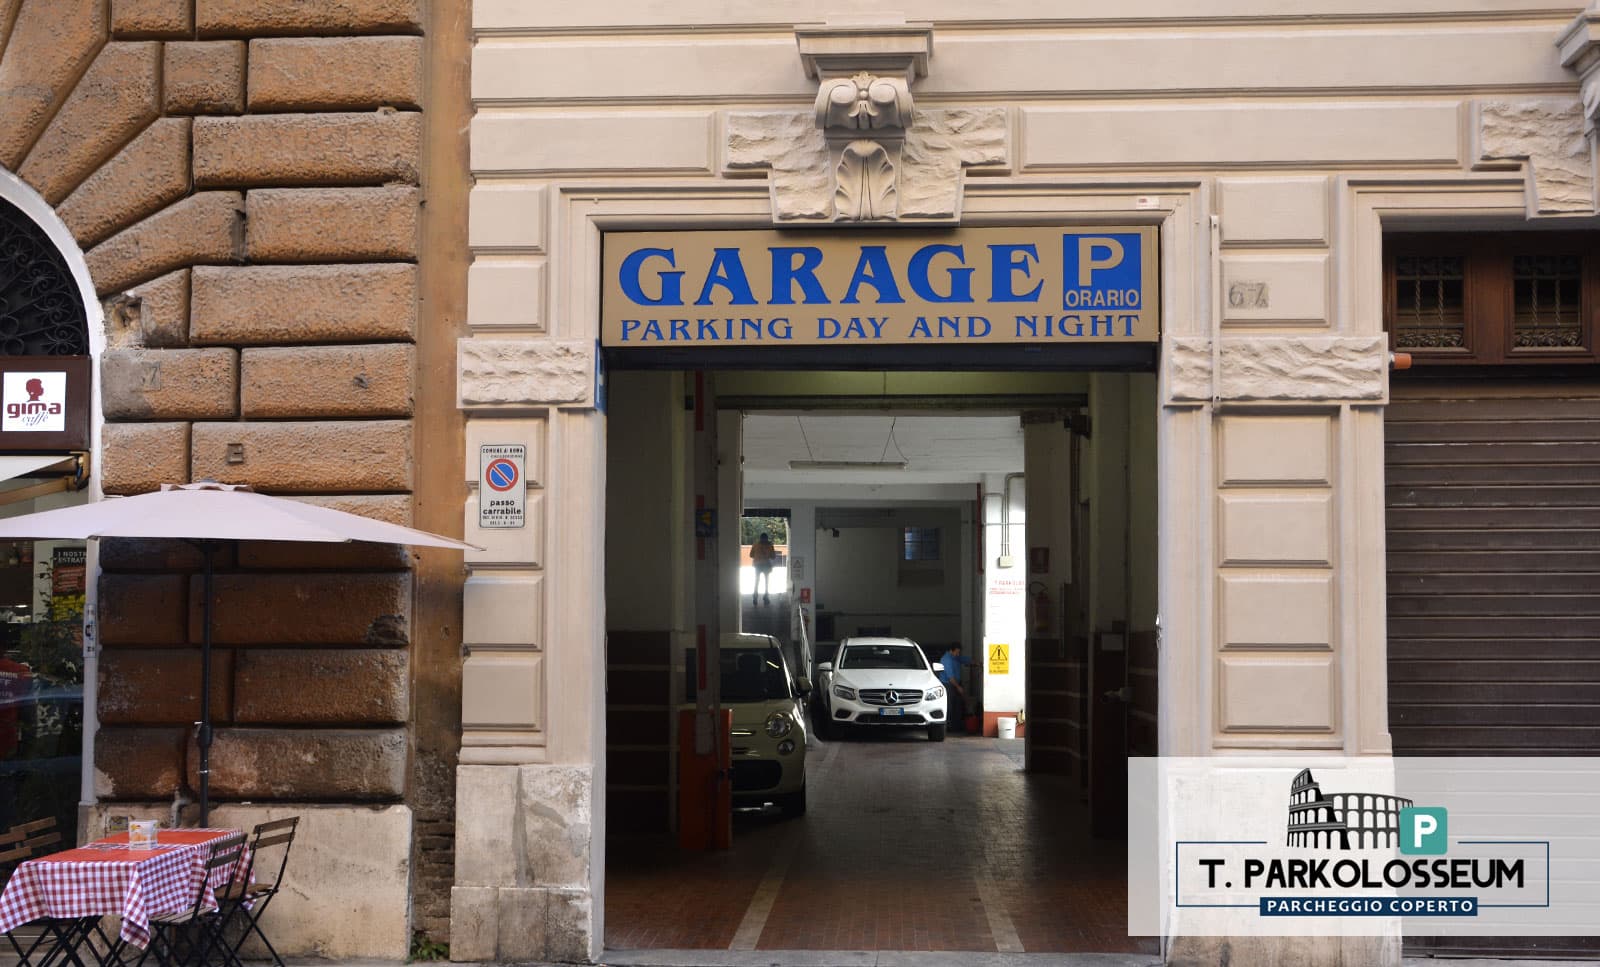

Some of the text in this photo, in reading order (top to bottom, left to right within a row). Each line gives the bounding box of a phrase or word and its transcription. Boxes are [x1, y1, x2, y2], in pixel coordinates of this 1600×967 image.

[1078, 237, 1125, 287] P
[619, 243, 1045, 306] GARAGE
[1065, 289, 1139, 308] ORARIO
[621, 314, 1140, 341] PARKING DAY AND NIGHT
[7, 402, 61, 419] gima
[482, 507, 522, 515] carrabile
